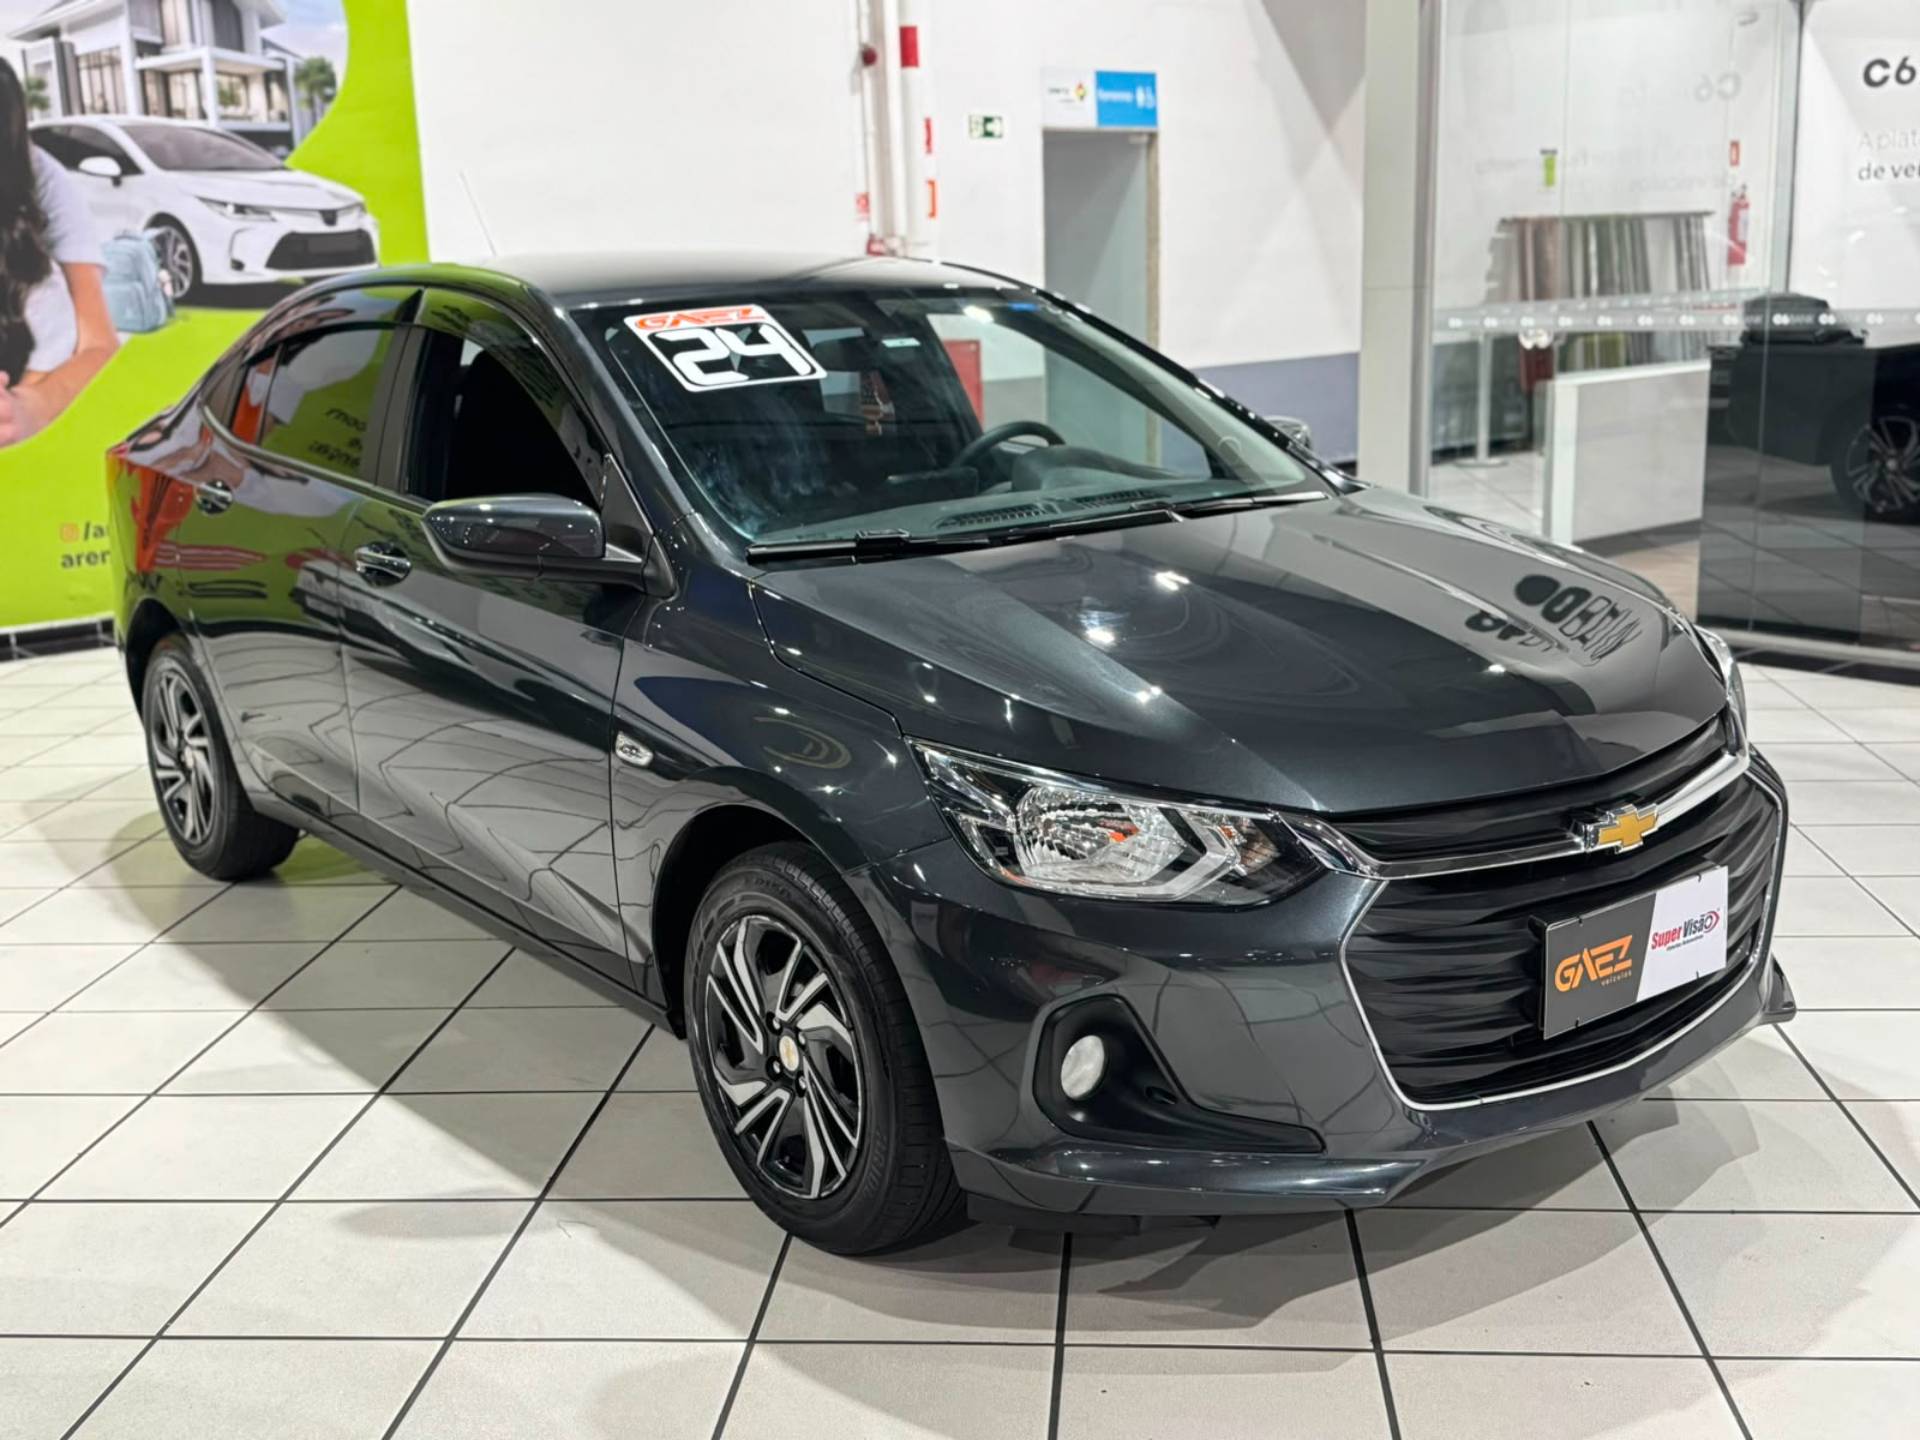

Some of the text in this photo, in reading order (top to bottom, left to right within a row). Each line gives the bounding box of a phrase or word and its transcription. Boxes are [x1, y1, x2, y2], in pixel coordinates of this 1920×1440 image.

[1863, 56, 1917, 88] C6
[1858, 162, 1886, 181] de
[635, 307, 766, 330] GAEZ
[654, 322, 812, 386] 24
[1651, 926, 1683, 950] Super
[1683, 911, 1717, 938] Visão
[1554, 934, 1633, 993] GAEZ
